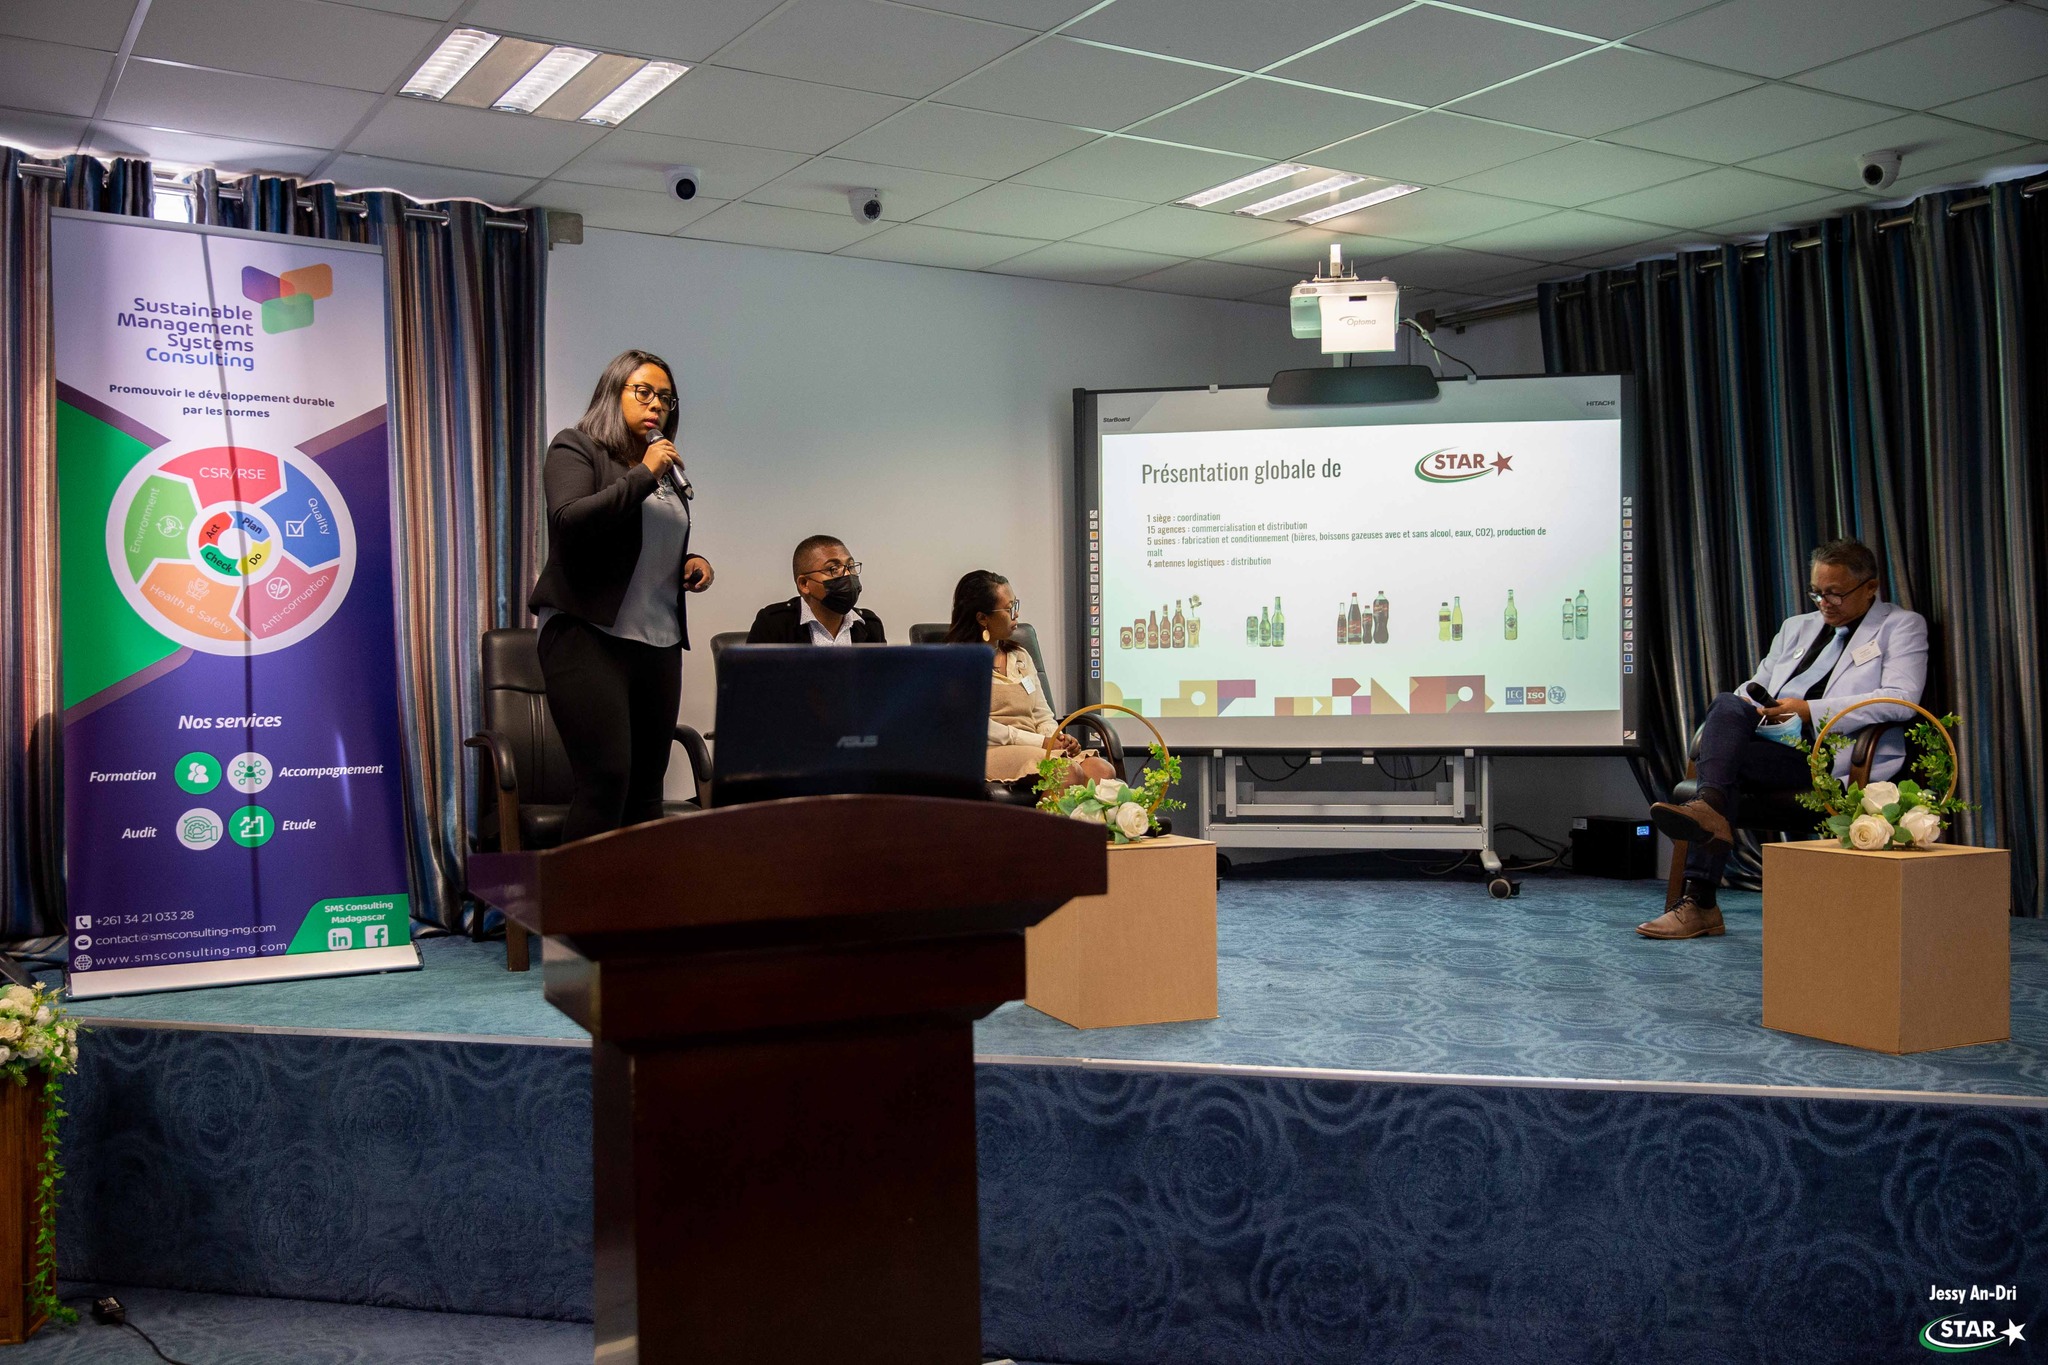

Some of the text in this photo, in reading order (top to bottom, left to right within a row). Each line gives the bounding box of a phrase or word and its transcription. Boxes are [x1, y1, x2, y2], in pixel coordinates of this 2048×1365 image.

[134, 297, 253, 321] Sustainable
[117, 312, 254, 337] Management
[1346, 317, 1376, 327] Optoma
[167, 333, 254, 352] Systems
[146, 347, 254, 371] Consulting
[109, 384, 335, 408] Promouvoir le développement durable
[182, 405, 270, 418] par les normes
[1434, 453, 1485, 470] STAR
[199, 467, 267, 480] CSR/RSE
[1142, 458, 1341, 485] Présentation globale de
[130, 487, 160, 554] Environment
[308, 498, 330, 535] Quality
[1153, 514, 1171, 523] siège
[1177, 512, 1221, 522] coordination
[206, 524, 220, 539] Act
[241, 517, 263, 534] Plan
[1147, 526, 1156, 534] 15
[1158, 526, 1186, 535] agences
[1192, 523, 1256, 533] commercialisation
[1258, 523, 1265, 531] et
[1267, 521, 1308, 531] distribution
[1147, 537, 1152, 545] 5
[1154, 537, 1176, 545] usines
[1182, 535, 1220, 545] fabrication
[1222, 535, 1229, 543] et
[1231, 533, 1289, 543] conditionnement
[1291, 532, 1318, 543] (bières,
[1319, 532, 1350, 540] boissons
[1351, 532, 1383, 541] gazeuses
[1385, 531, 1401, 539] avec
[1402, 530, 1410, 538] et
[1412, 530, 1428, 538] sans
[1430, 529, 1453, 538] alcool,
[1455, 529, 1474, 538] eaux,
[1497, 527, 1536, 537] production
[1537, 527, 1547, 535] de
[249, 553, 262, 566] Do
[1147, 549, 1163, 557] malt
[205, 552, 233, 573] Check
[1147, 560, 1152, 568] 4
[1154, 559, 1185, 567] antennes
[1187, 557, 1225, 568] logistiques
[1231, 557, 1272, 566] distribution
[149, 583, 232, 634] Health & Safety
[261, 574, 329, 633] Anti-corruption
[1507, 690, 1522, 698] IEC
[178, 714, 282, 729] Nos services
[89, 770, 157, 782] Formation
[279, 764, 384, 779] Accompagnement
[282, 819, 317, 831] Etude
[122, 827, 157, 839] Audit
[324, 901, 394, 913] SMS Consulting
[95, 911, 195, 926] +261 34 21 033 28
[331, 914, 386, 924] Madagascar
[95, 923, 277, 947] contact@smsconsulting-mg.com
[95, 943, 287, 966] www.smsconsulting-mg.com
